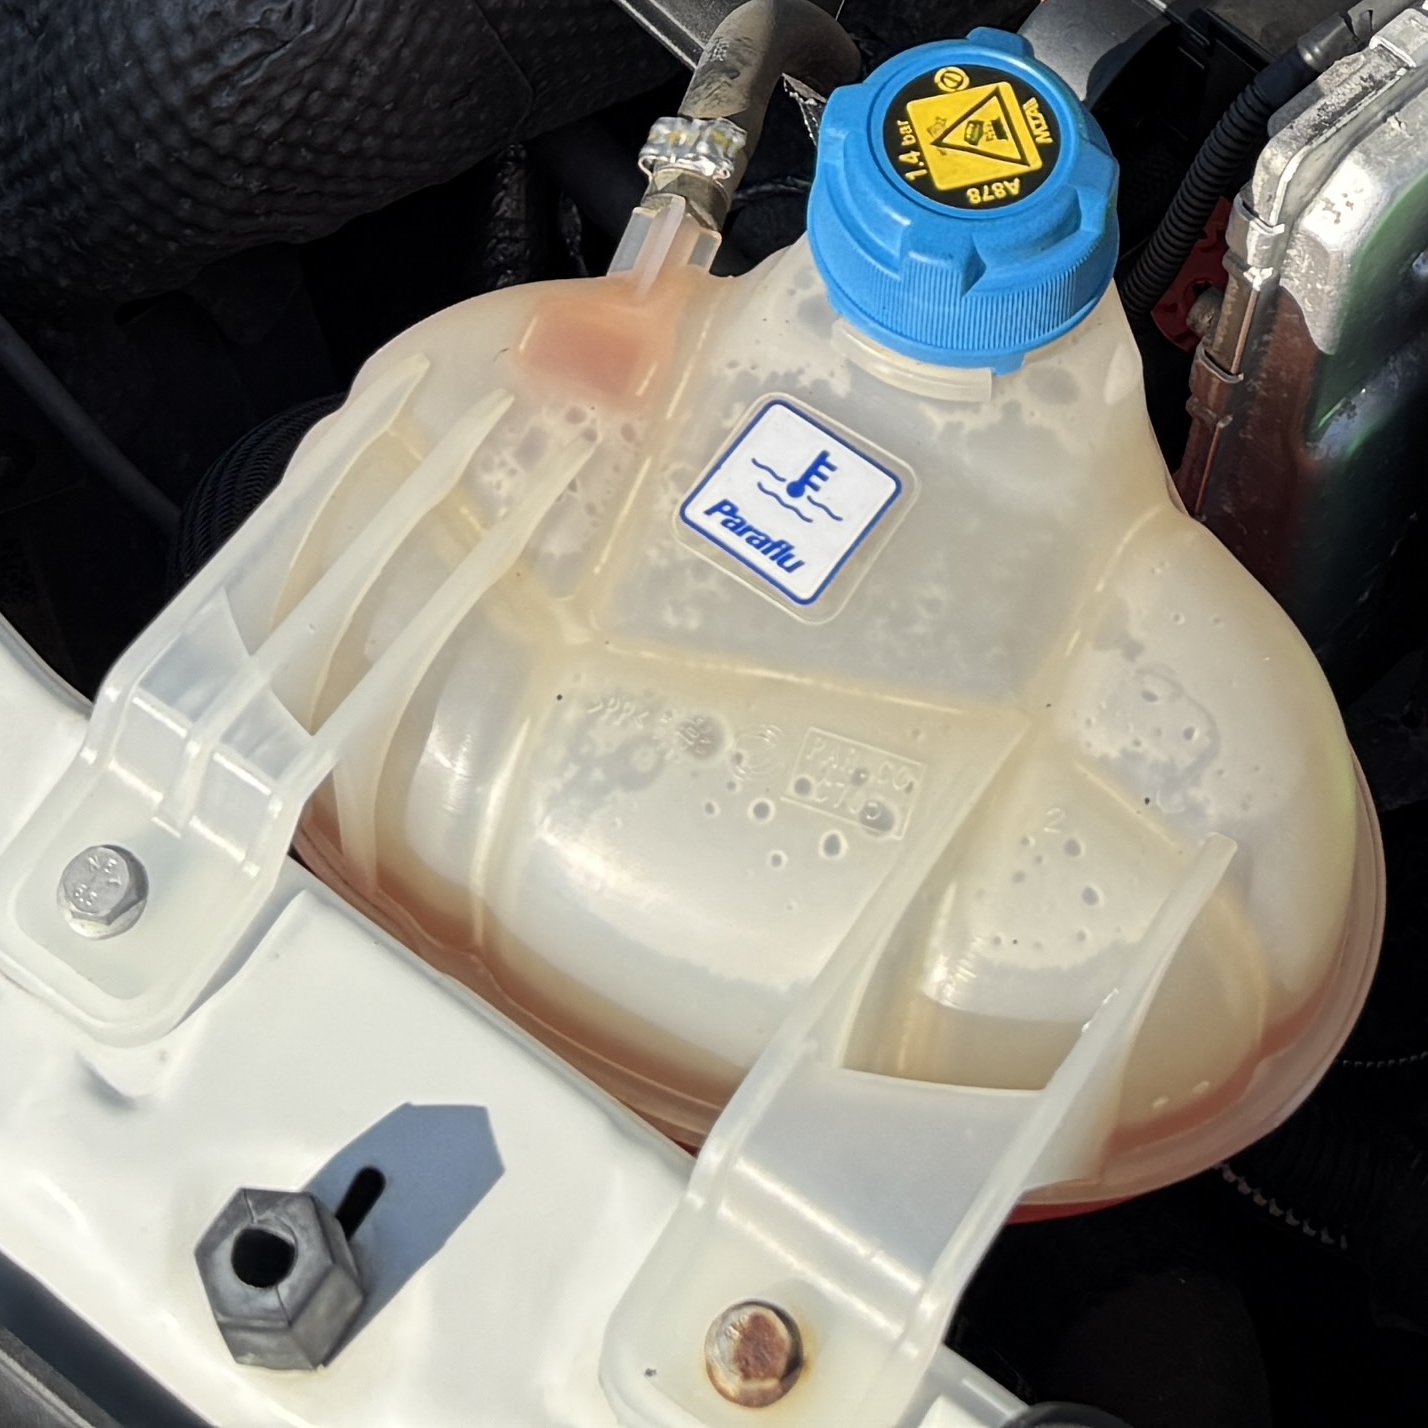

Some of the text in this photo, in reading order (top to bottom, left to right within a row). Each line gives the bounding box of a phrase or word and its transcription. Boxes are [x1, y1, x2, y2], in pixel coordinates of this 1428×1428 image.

[896, 119, 928, 181] 1.4 bar
[965, 178, 1022, 205] A878
[703, 496, 805, 574] Paraflu
